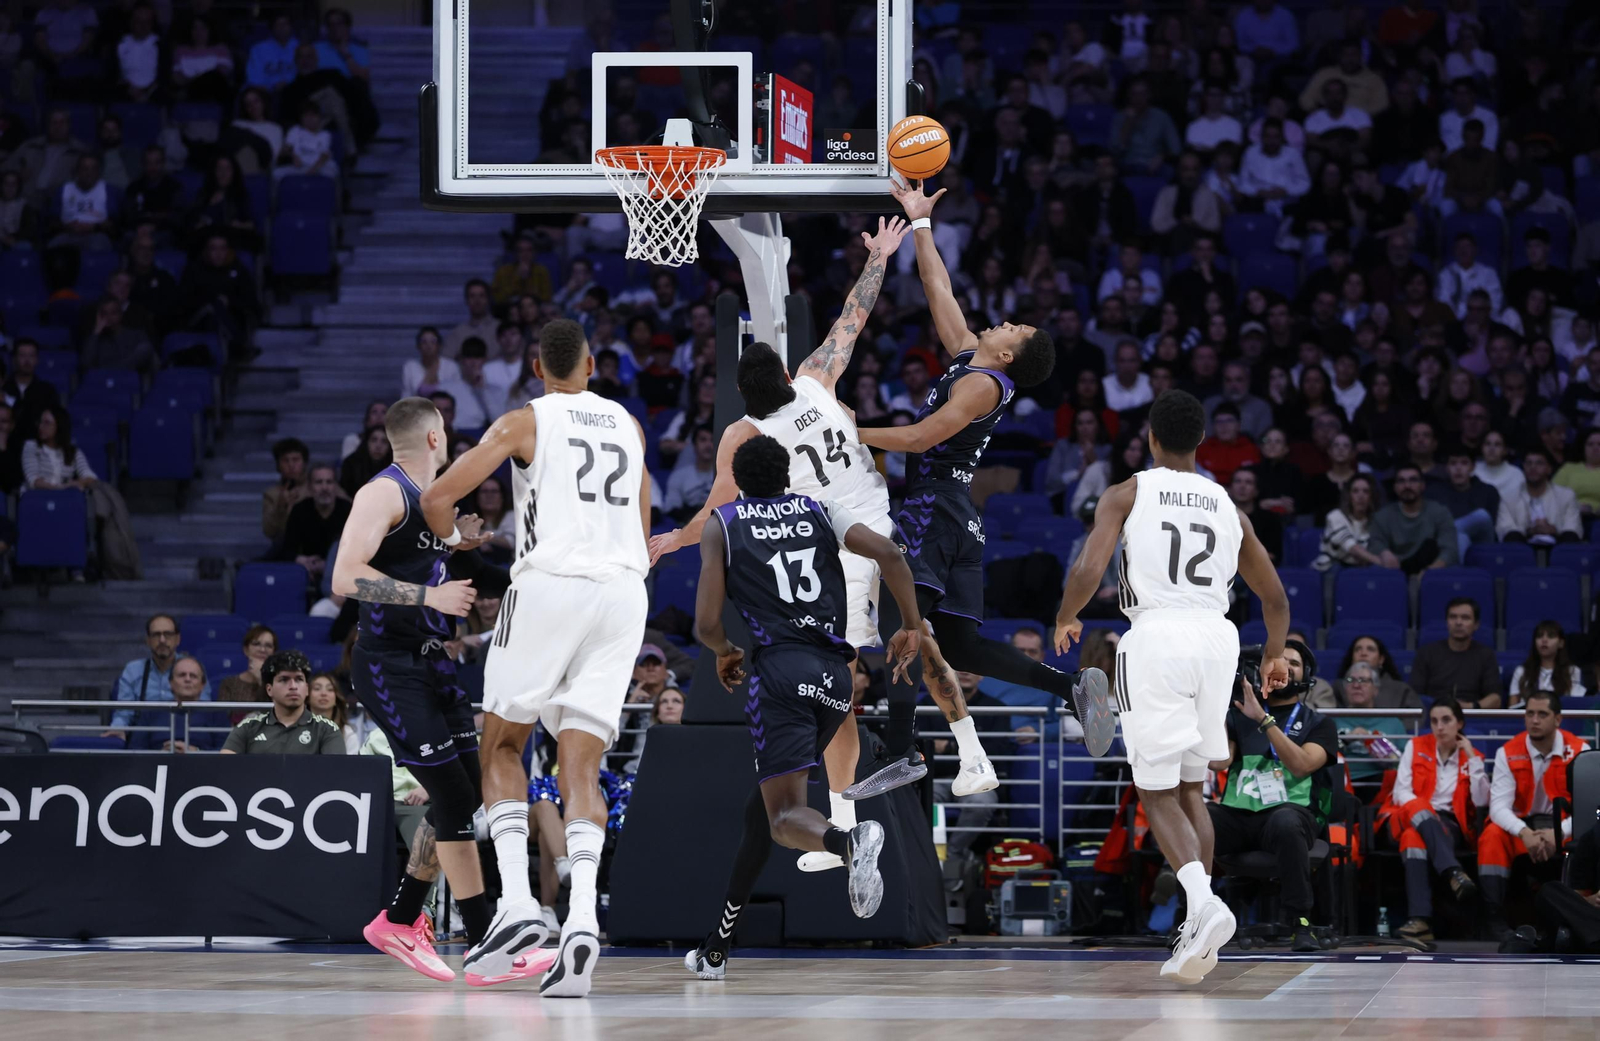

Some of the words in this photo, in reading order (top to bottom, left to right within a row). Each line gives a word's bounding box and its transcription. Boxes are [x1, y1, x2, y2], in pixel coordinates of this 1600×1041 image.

[827, 138, 849, 151] liga
[899, 130, 941, 149] Wilson
[827, 149, 876, 161] endesa
[567, 409, 617, 429] TAVARES
[794, 406, 823, 432] DECK
[794, 427, 852, 487] 14
[568, 438, 630, 506] 22
[1159, 491, 1219, 513] MALEDON
[750, 522, 796, 540] bbk
[1161, 521, 1217, 587] 12
[766, 546, 822, 604] 13
